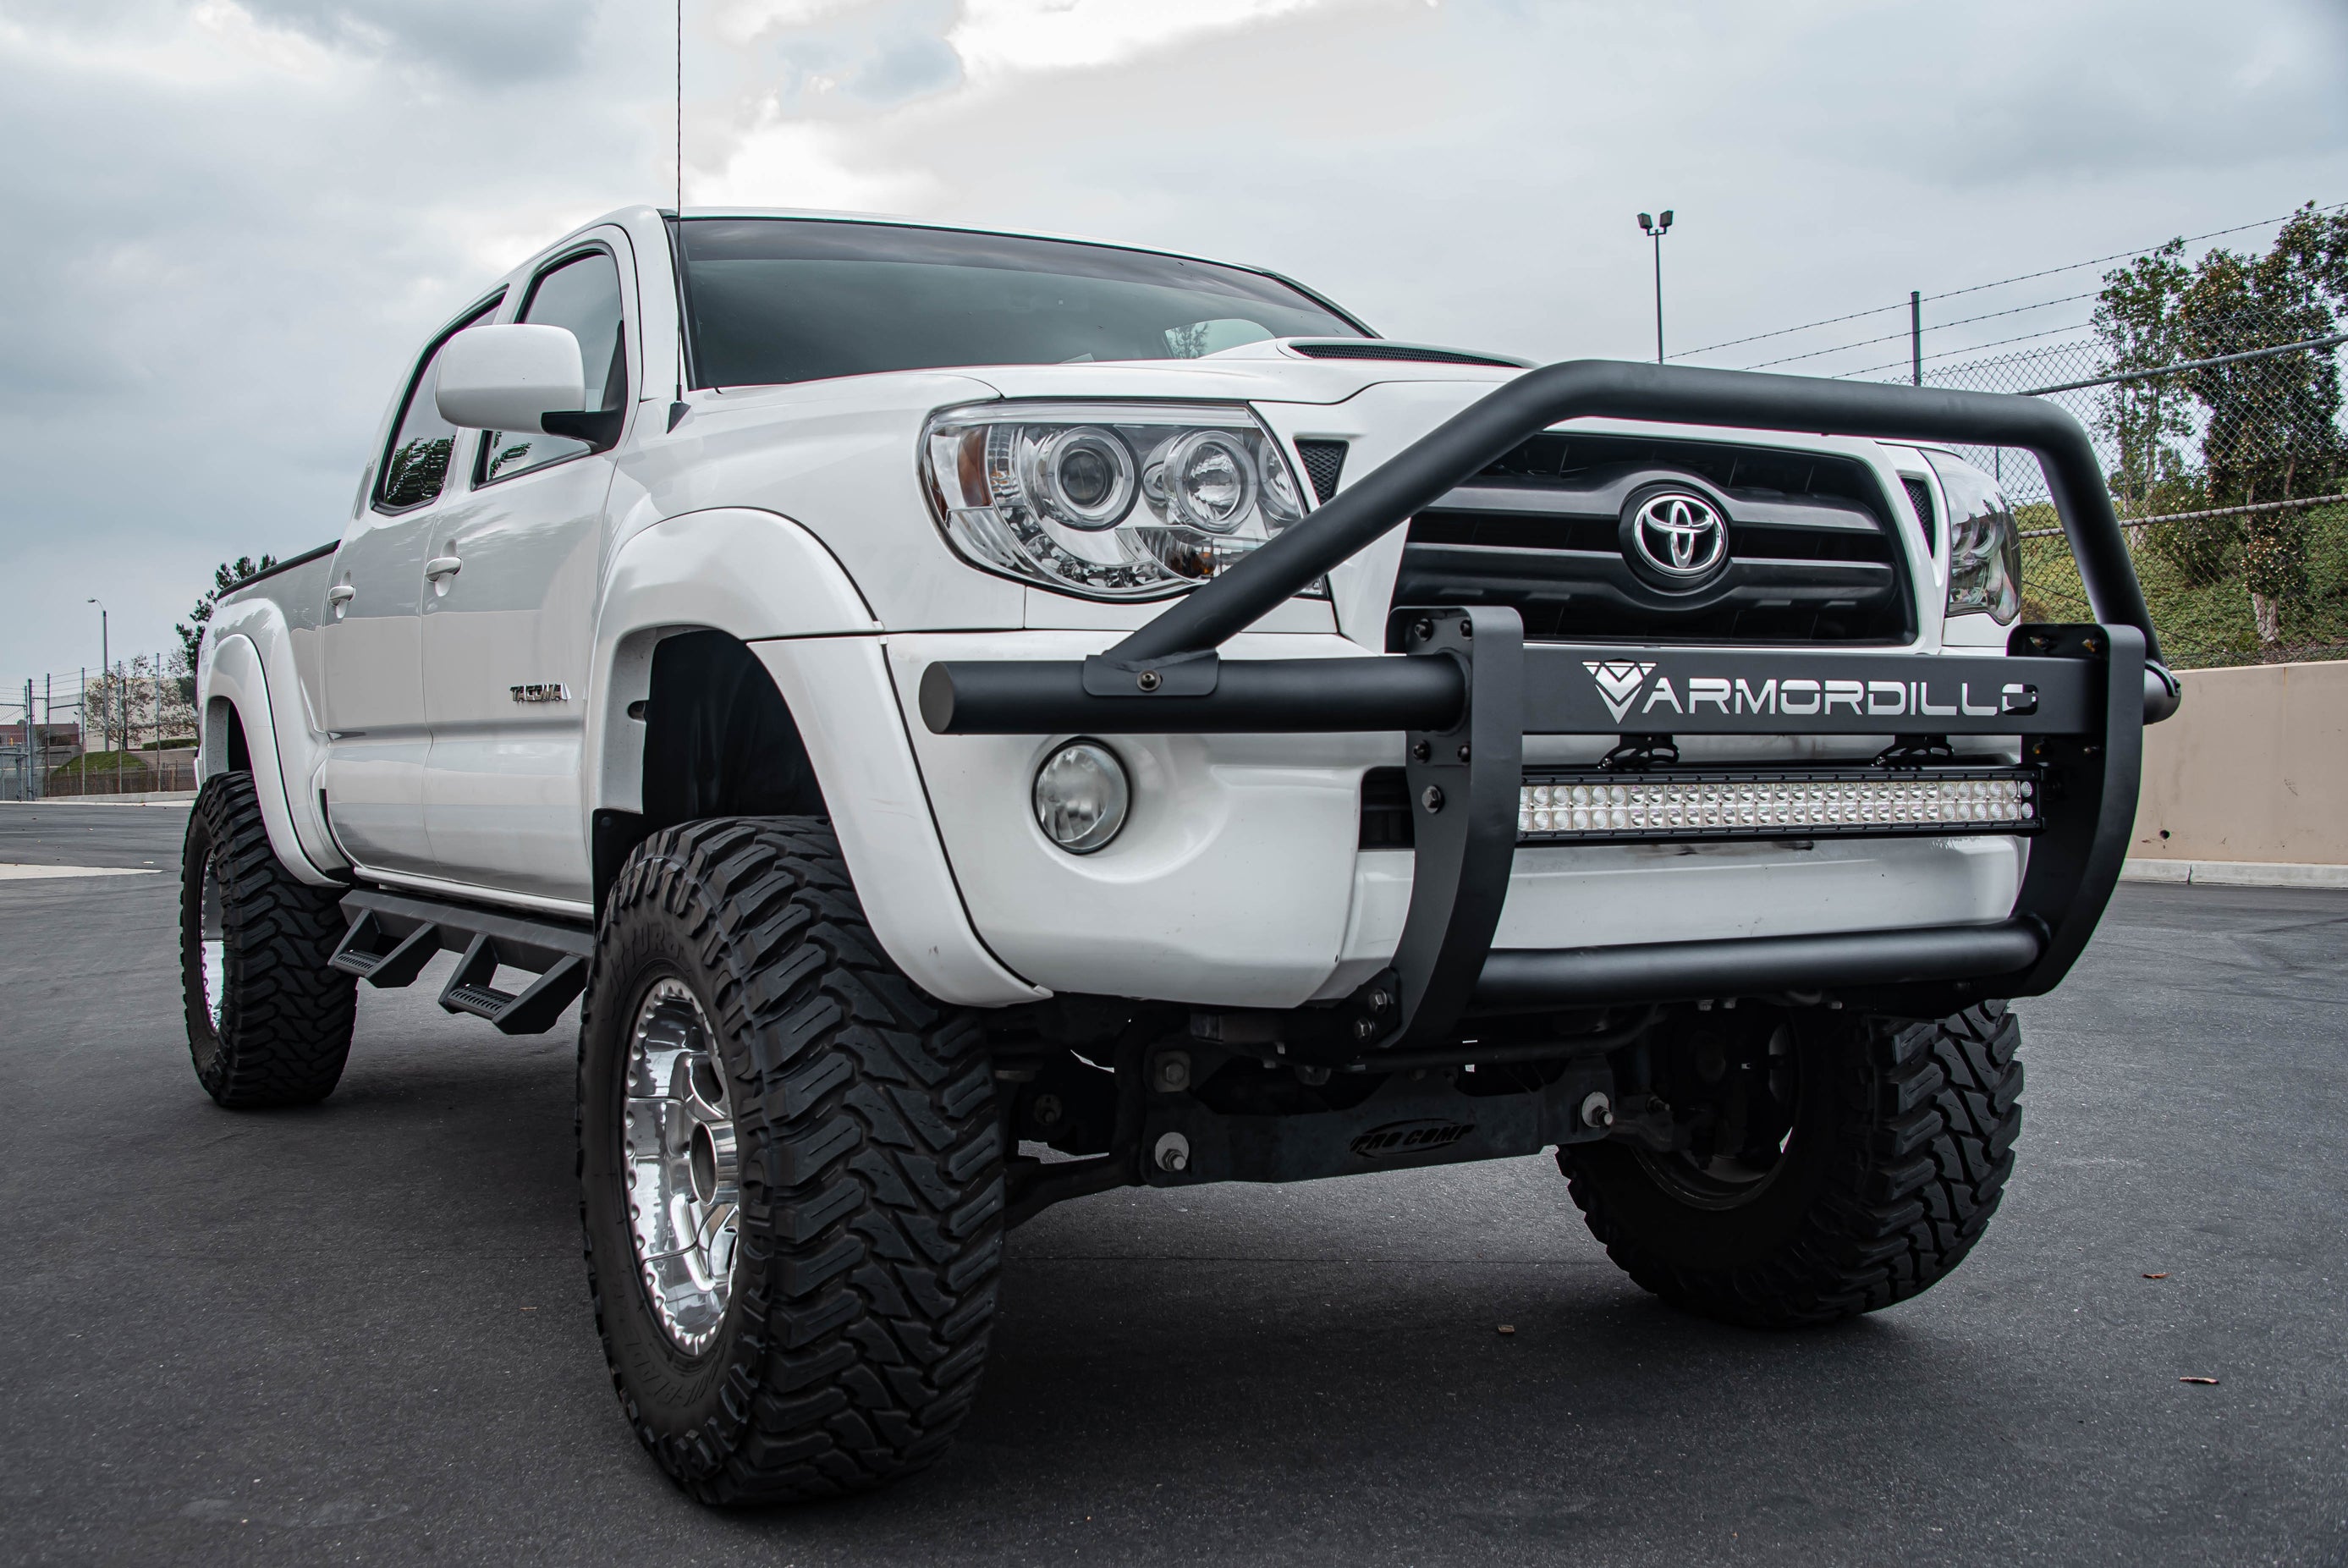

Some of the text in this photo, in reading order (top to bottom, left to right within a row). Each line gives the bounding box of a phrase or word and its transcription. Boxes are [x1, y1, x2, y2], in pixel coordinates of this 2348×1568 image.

[509, 682, 572, 702] TACOMA
[1641, 677, 2039, 716] ARMORDILLO
[1350, 1124, 1476, 1152] PRO COMP
